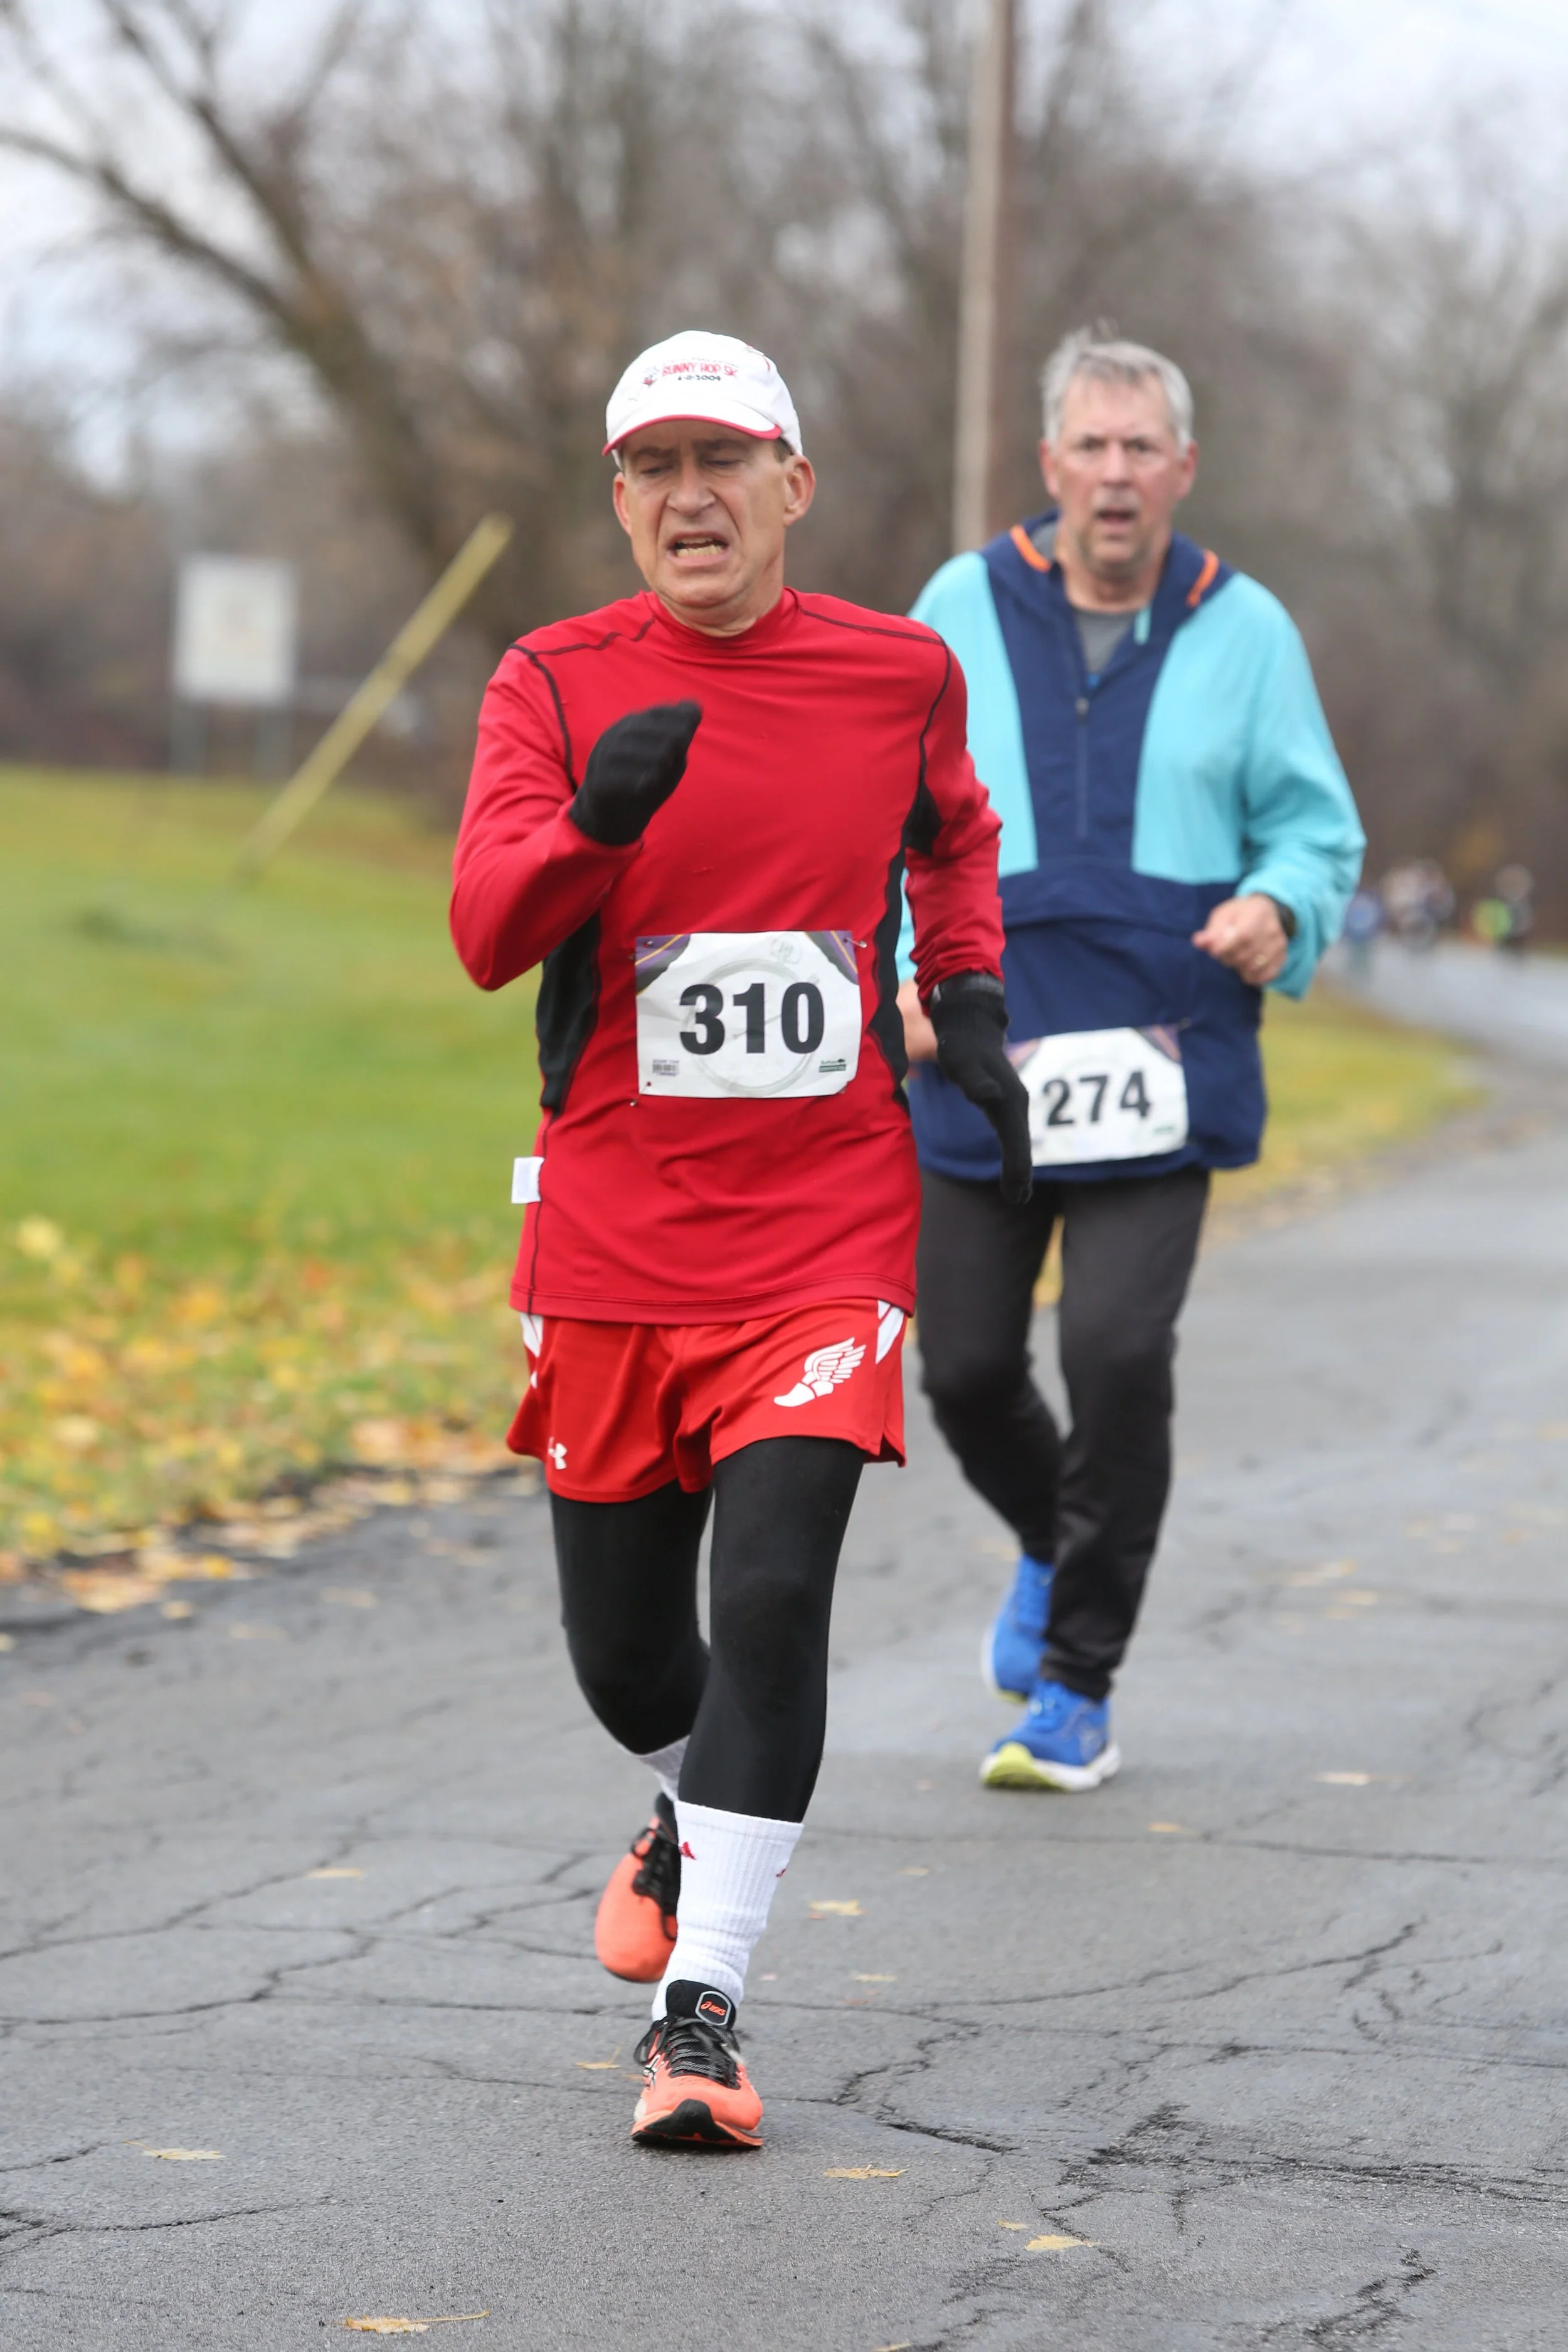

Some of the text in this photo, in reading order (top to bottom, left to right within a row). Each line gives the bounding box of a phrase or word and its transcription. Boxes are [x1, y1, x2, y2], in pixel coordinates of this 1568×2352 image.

[700, 363, 721, 373] HOP
[679, 982, 824, 1055] 310
[1042, 1069, 1152, 1127] 274
